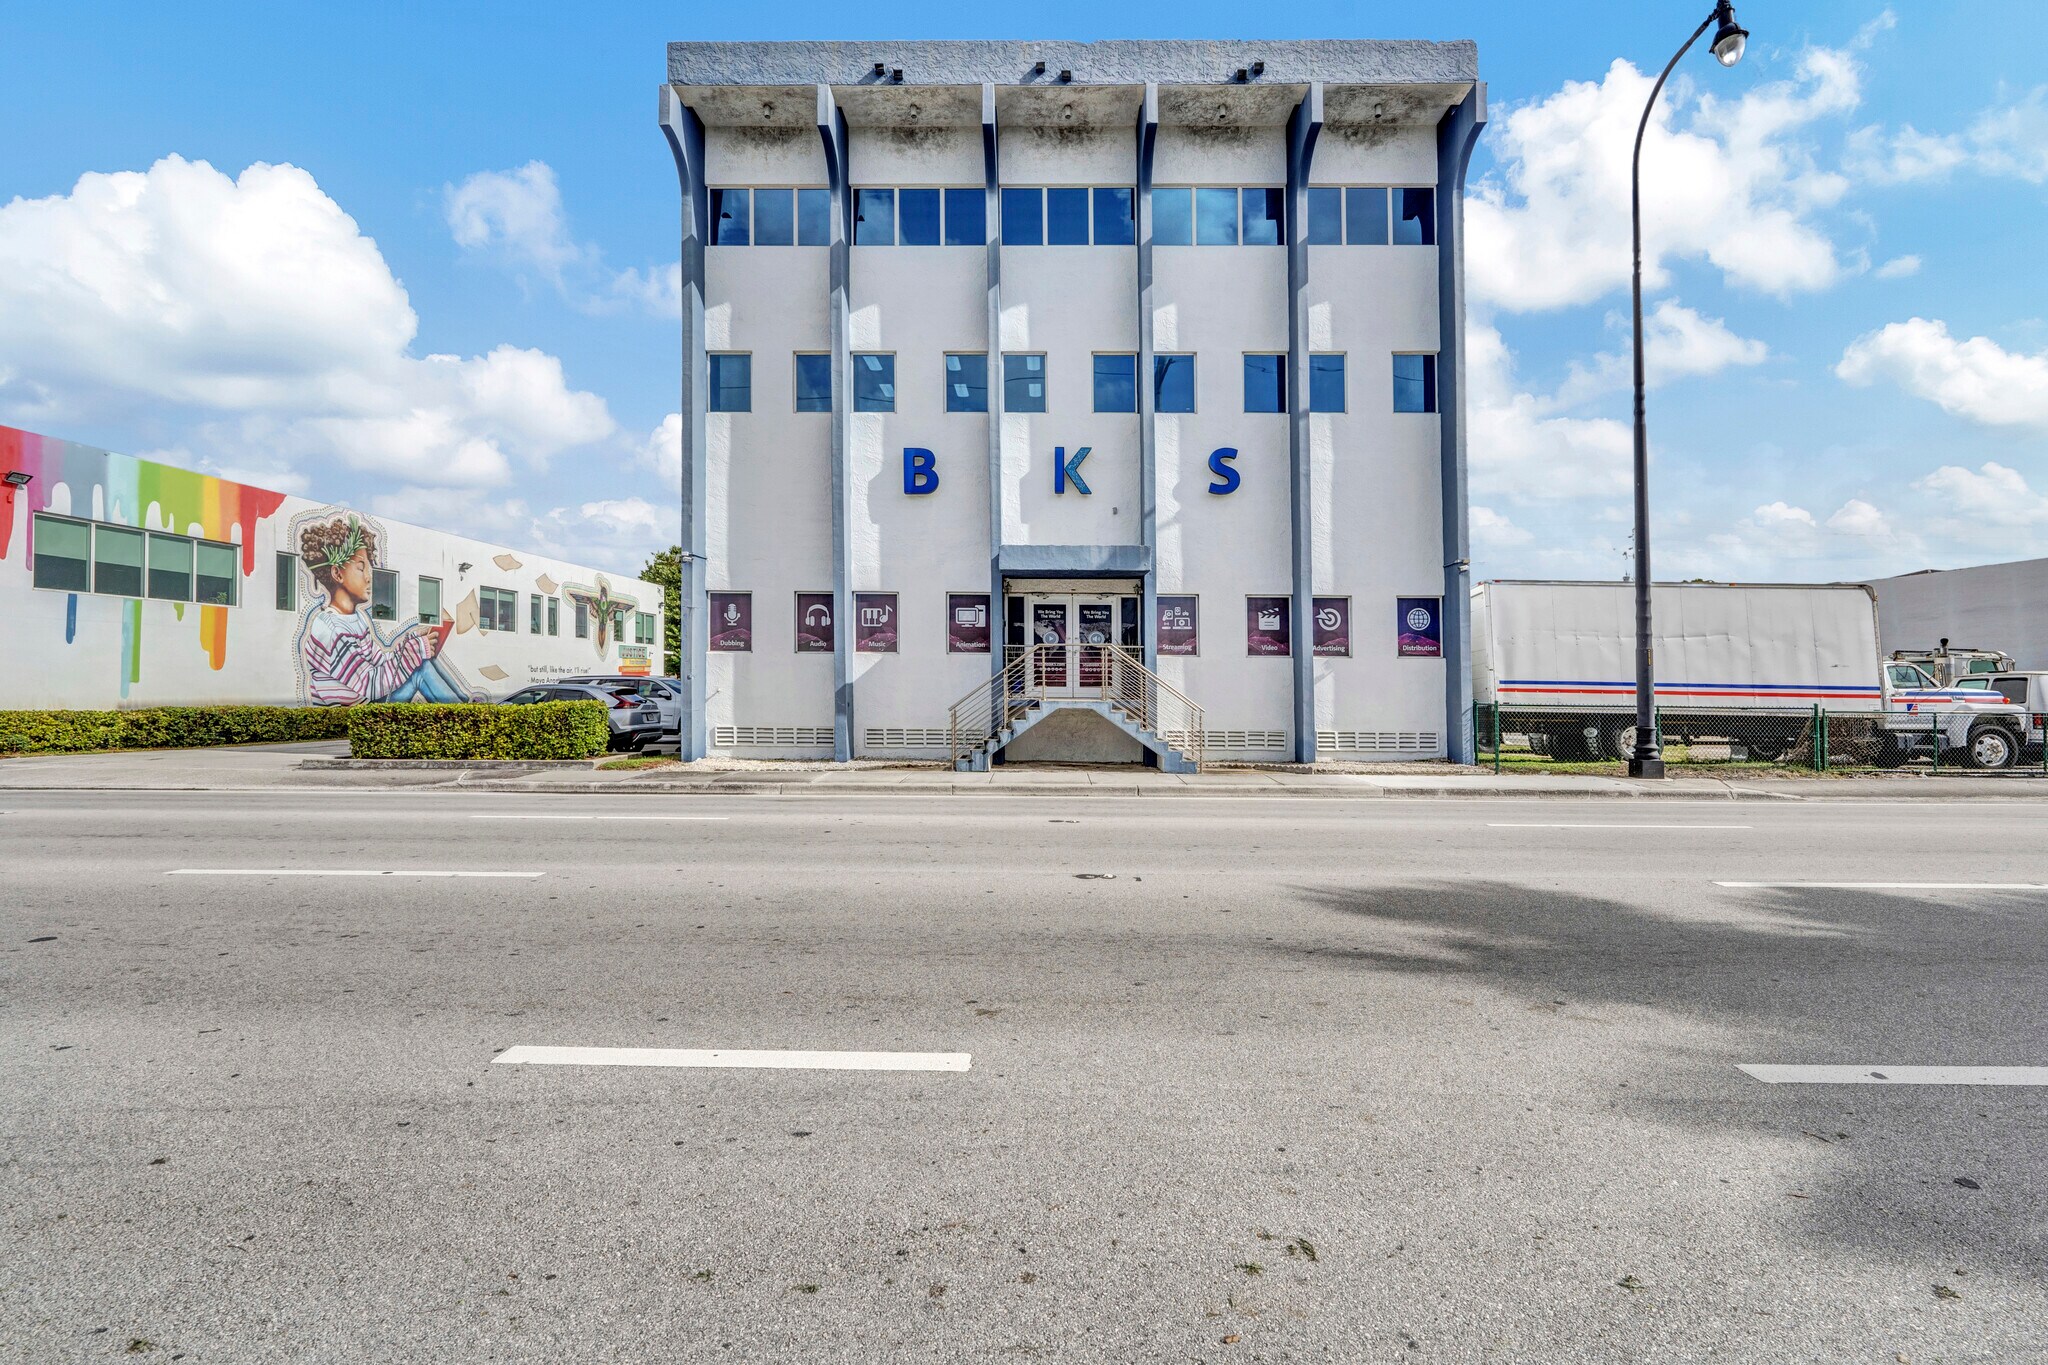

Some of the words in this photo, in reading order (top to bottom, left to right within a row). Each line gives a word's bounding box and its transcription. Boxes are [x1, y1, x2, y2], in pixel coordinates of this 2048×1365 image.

[904, 448, 939, 494] B
[1055, 447, 1092, 494] K
[1208, 447, 1241, 495] S
[622, 648, 645, 657] JUSTICE
